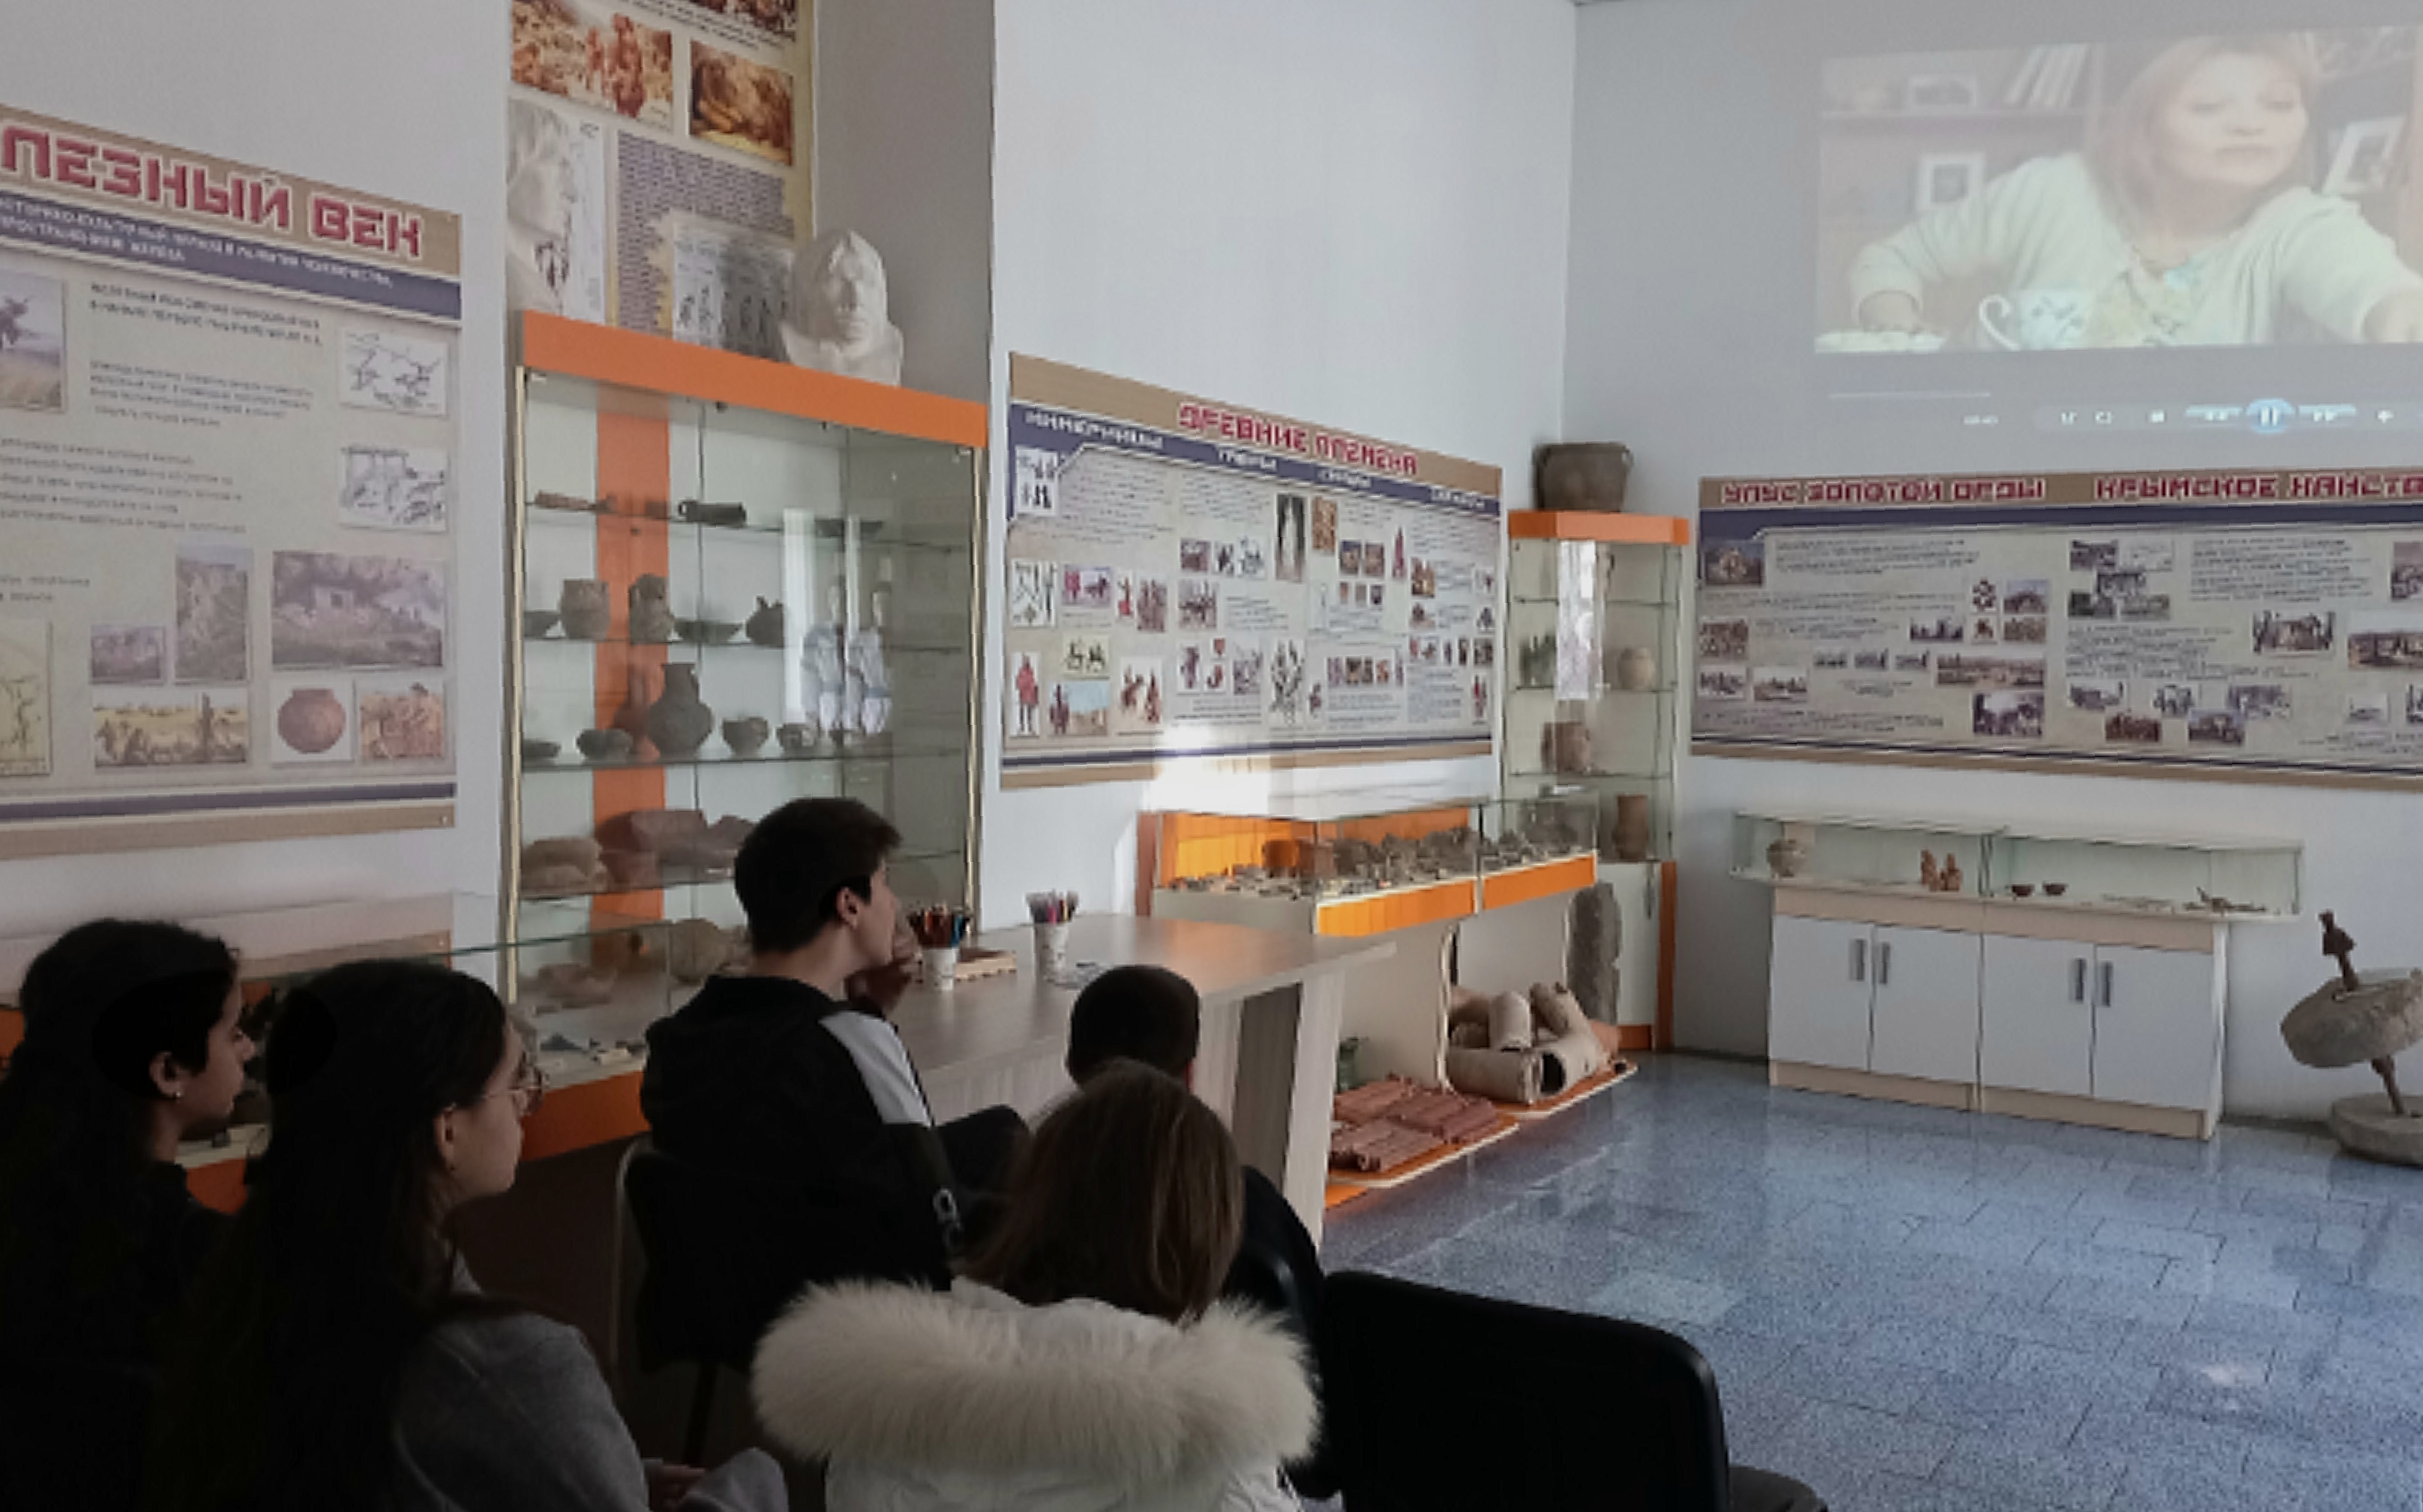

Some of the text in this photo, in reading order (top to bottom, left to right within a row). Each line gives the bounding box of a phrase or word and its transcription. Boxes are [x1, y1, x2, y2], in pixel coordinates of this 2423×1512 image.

[313, 197, 420, 258] ВЕК
[1179, 403, 1417, 475] ДРЕВНИЕ ПЛЕМЕНА
[1721, 479, 2045, 504] УЛУС ЗОЛОТОЙ ОРДЫ
[2094, 475, 2277, 499] КРЫМСКОЕ
